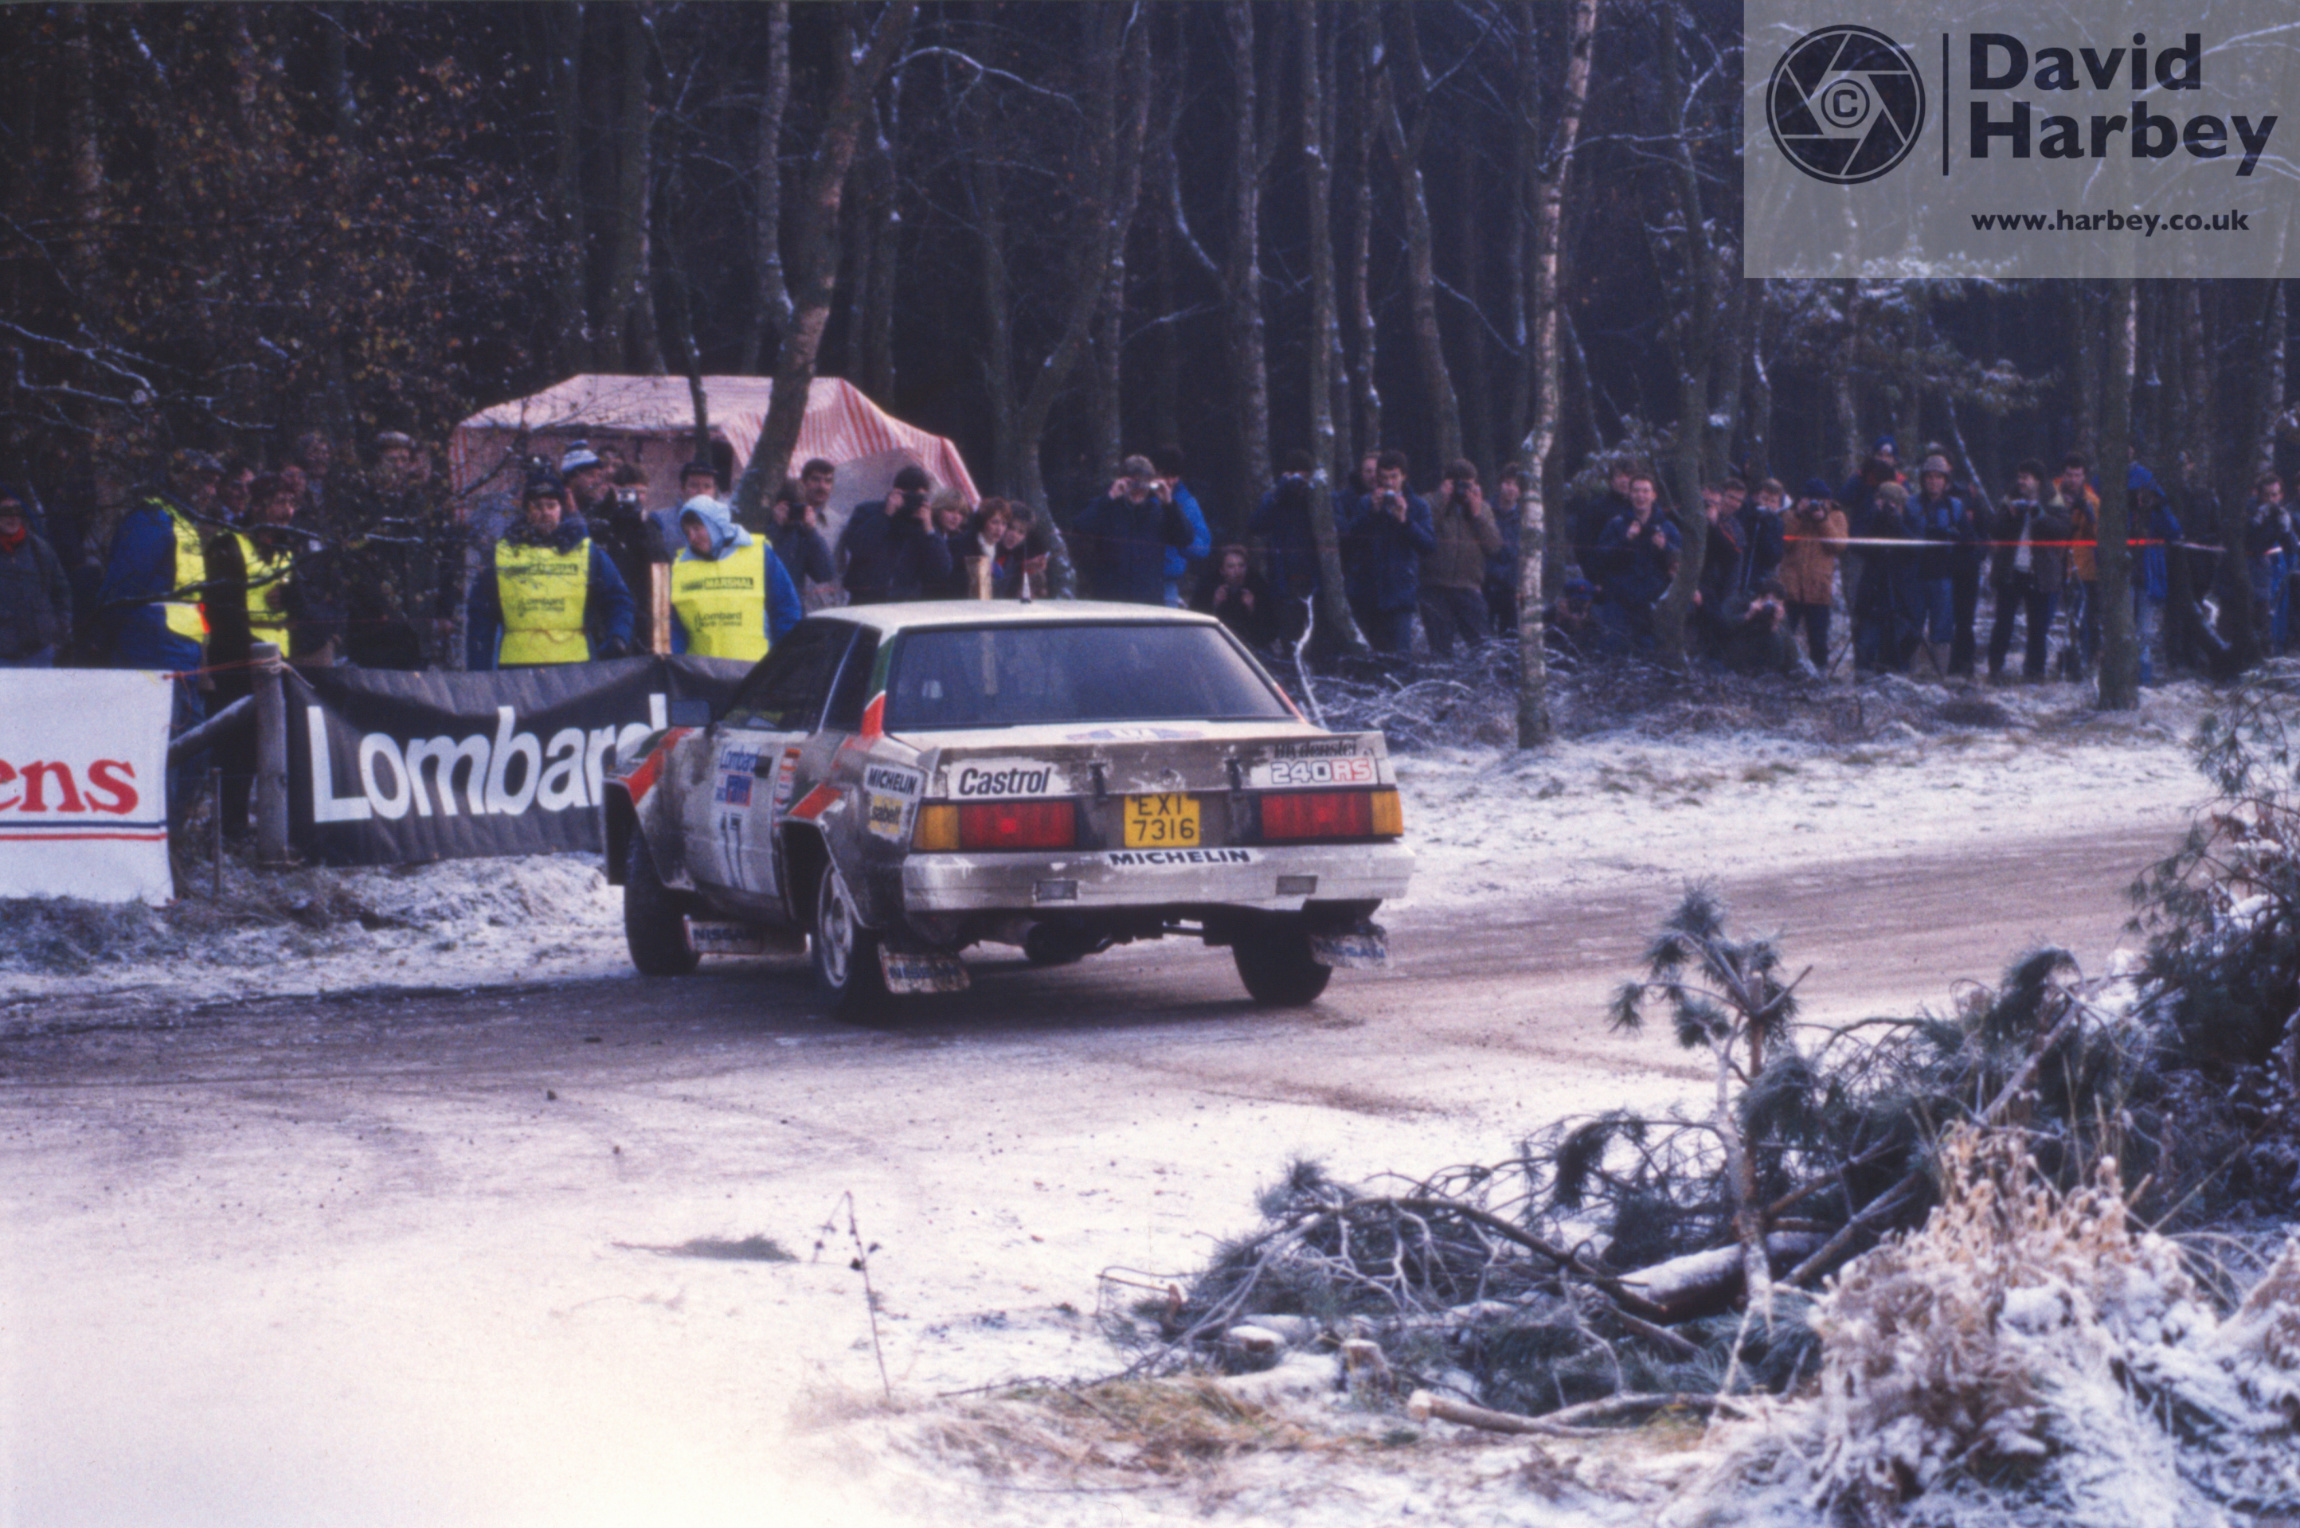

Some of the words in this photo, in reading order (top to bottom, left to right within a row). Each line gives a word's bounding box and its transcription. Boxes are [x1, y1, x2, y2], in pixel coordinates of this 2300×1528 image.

[307, 693, 668, 823] Lombard
[1271, 758, 1372, 784] 240RS
[867, 767, 918, 796] MICHELIN
[959, 767, 1051, 796] Castrol
[1138, 794, 1182, 816] EXI
[1133, 818, 1195, 841] 7316
[1109, 850, 1251, 865] MICHELIN
